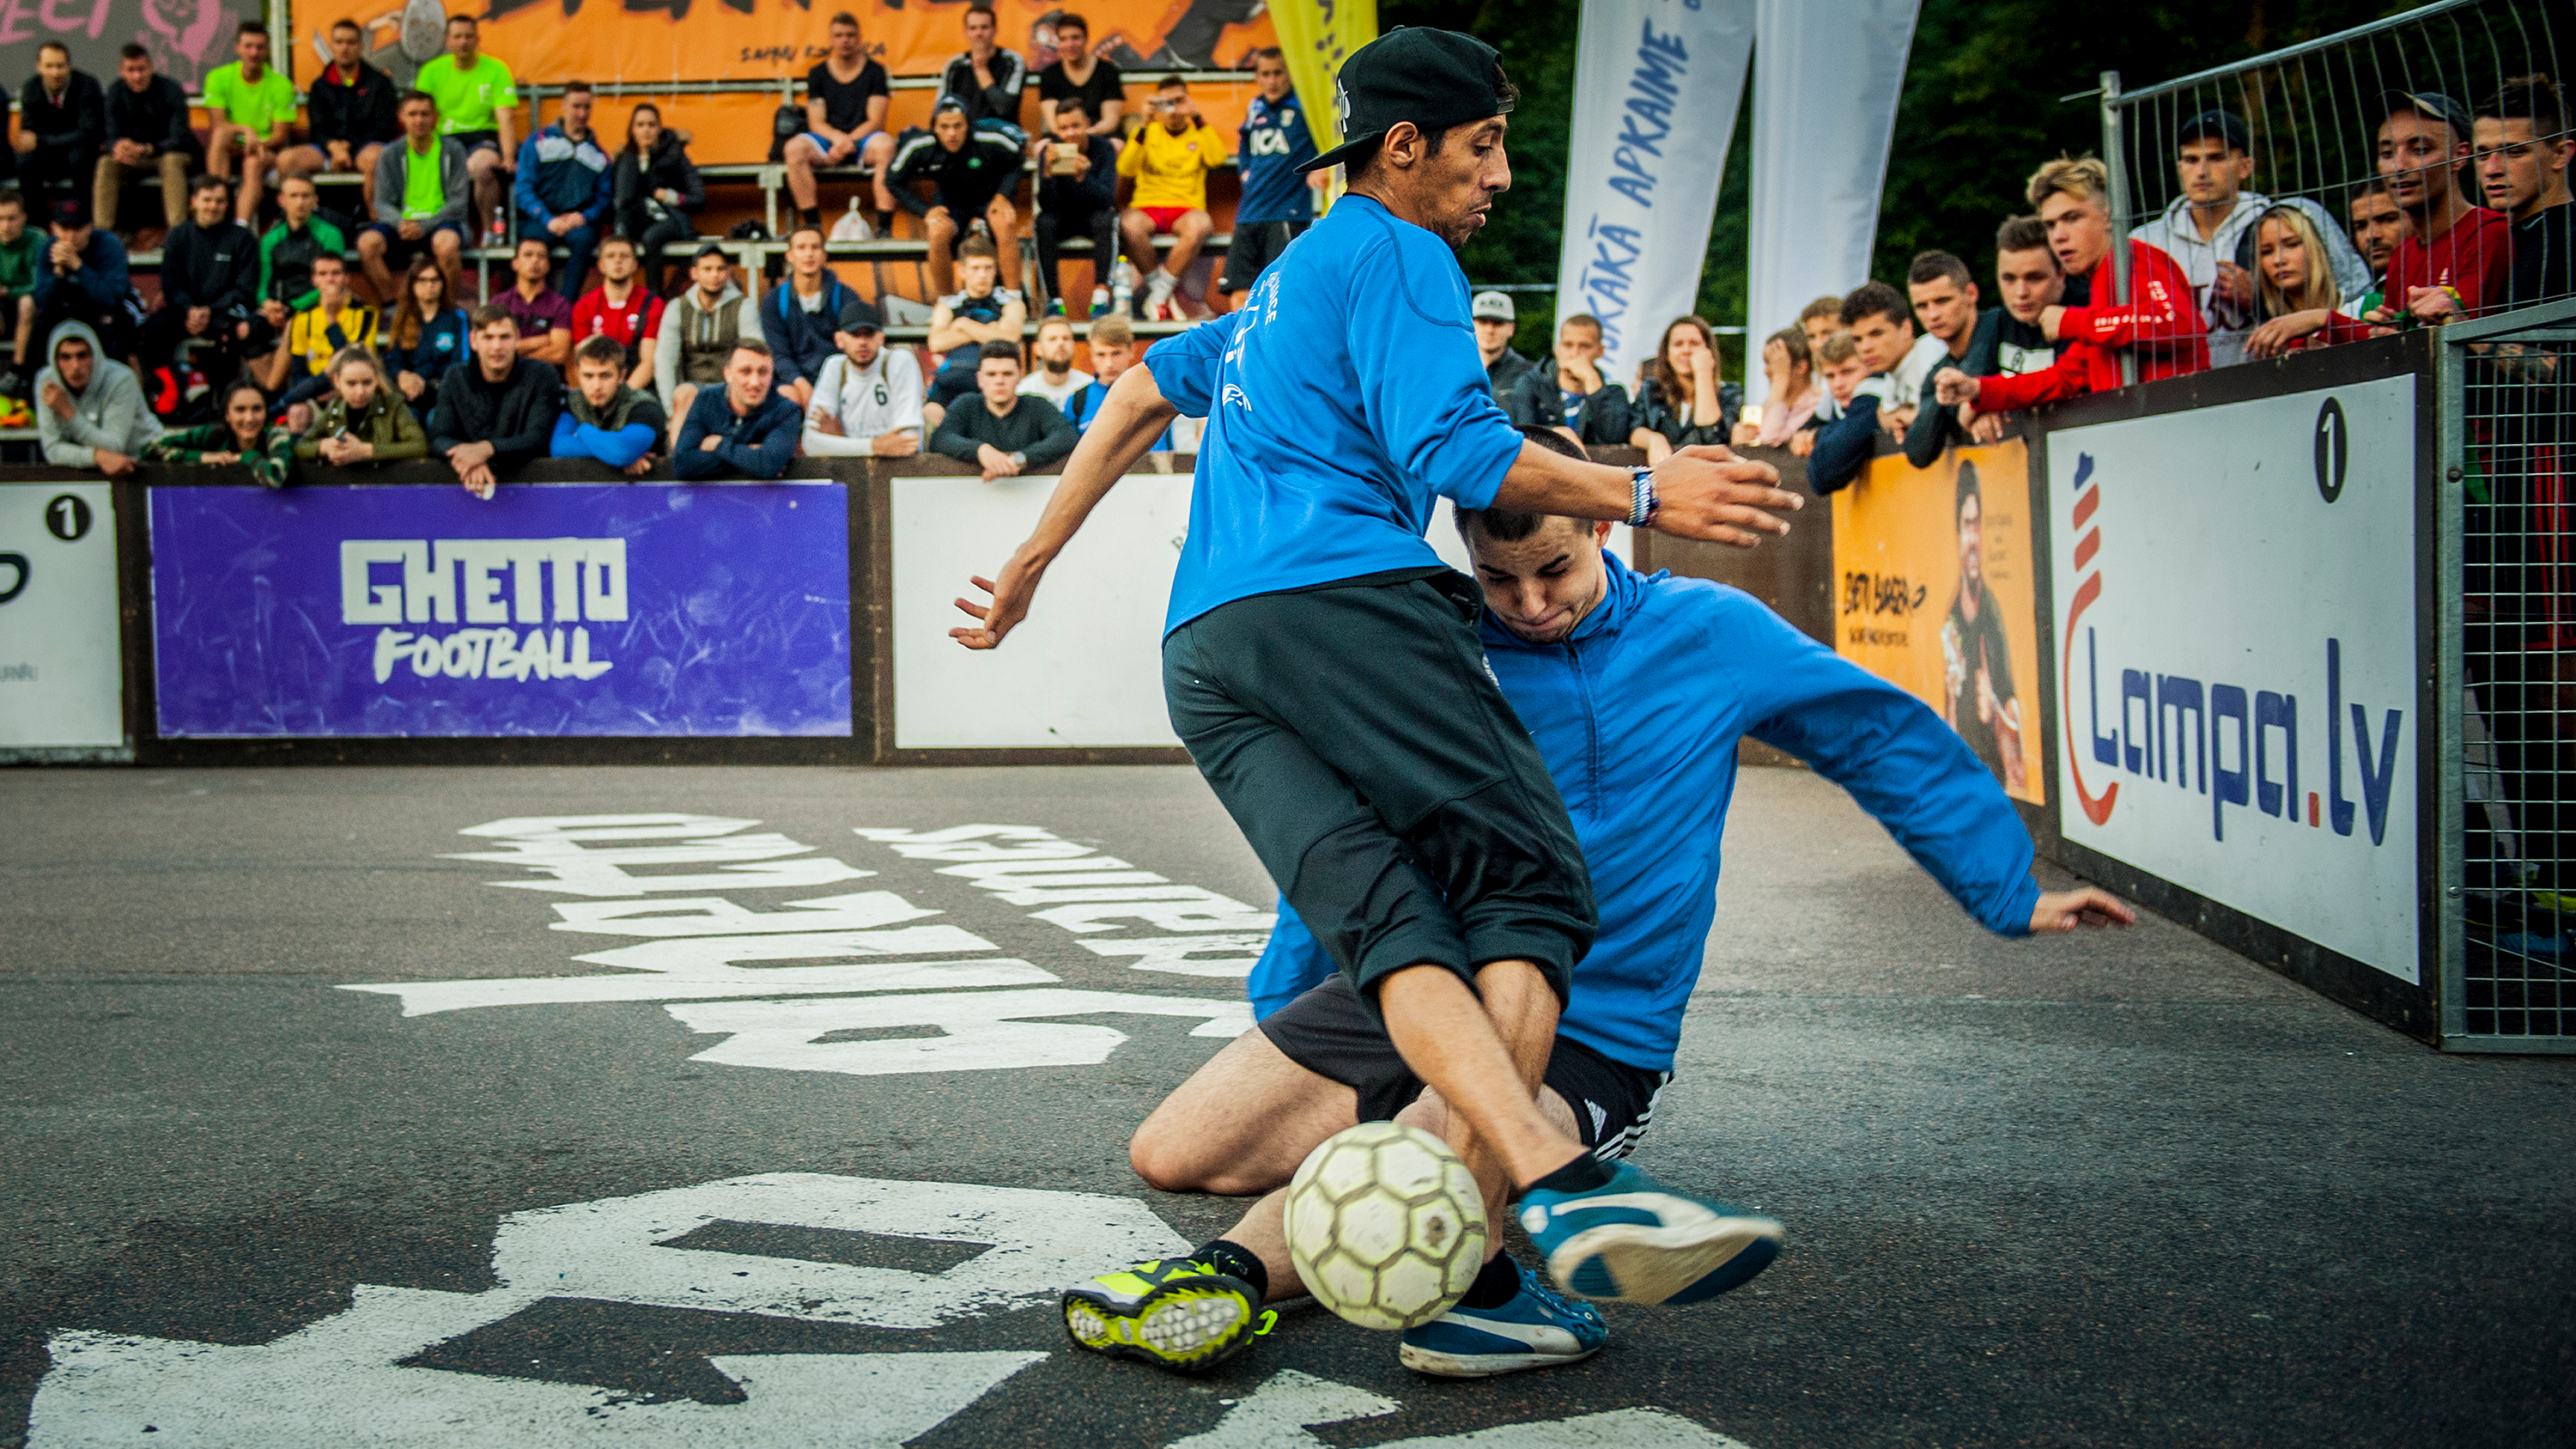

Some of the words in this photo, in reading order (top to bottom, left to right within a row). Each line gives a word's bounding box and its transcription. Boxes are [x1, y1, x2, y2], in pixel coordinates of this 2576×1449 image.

[1250, 128, 1291, 156] ICA
[1608, 17, 1690, 208] APKAIME
[874, 384, 888, 406] 6
[2322, 412, 2336, 488] 1
[56, 497, 77, 538] 1
[341, 538, 628, 624] GHETTO
[374, 625, 613, 684] FOOTBALL
[2088, 625, 2403, 846] Lampa.lv
